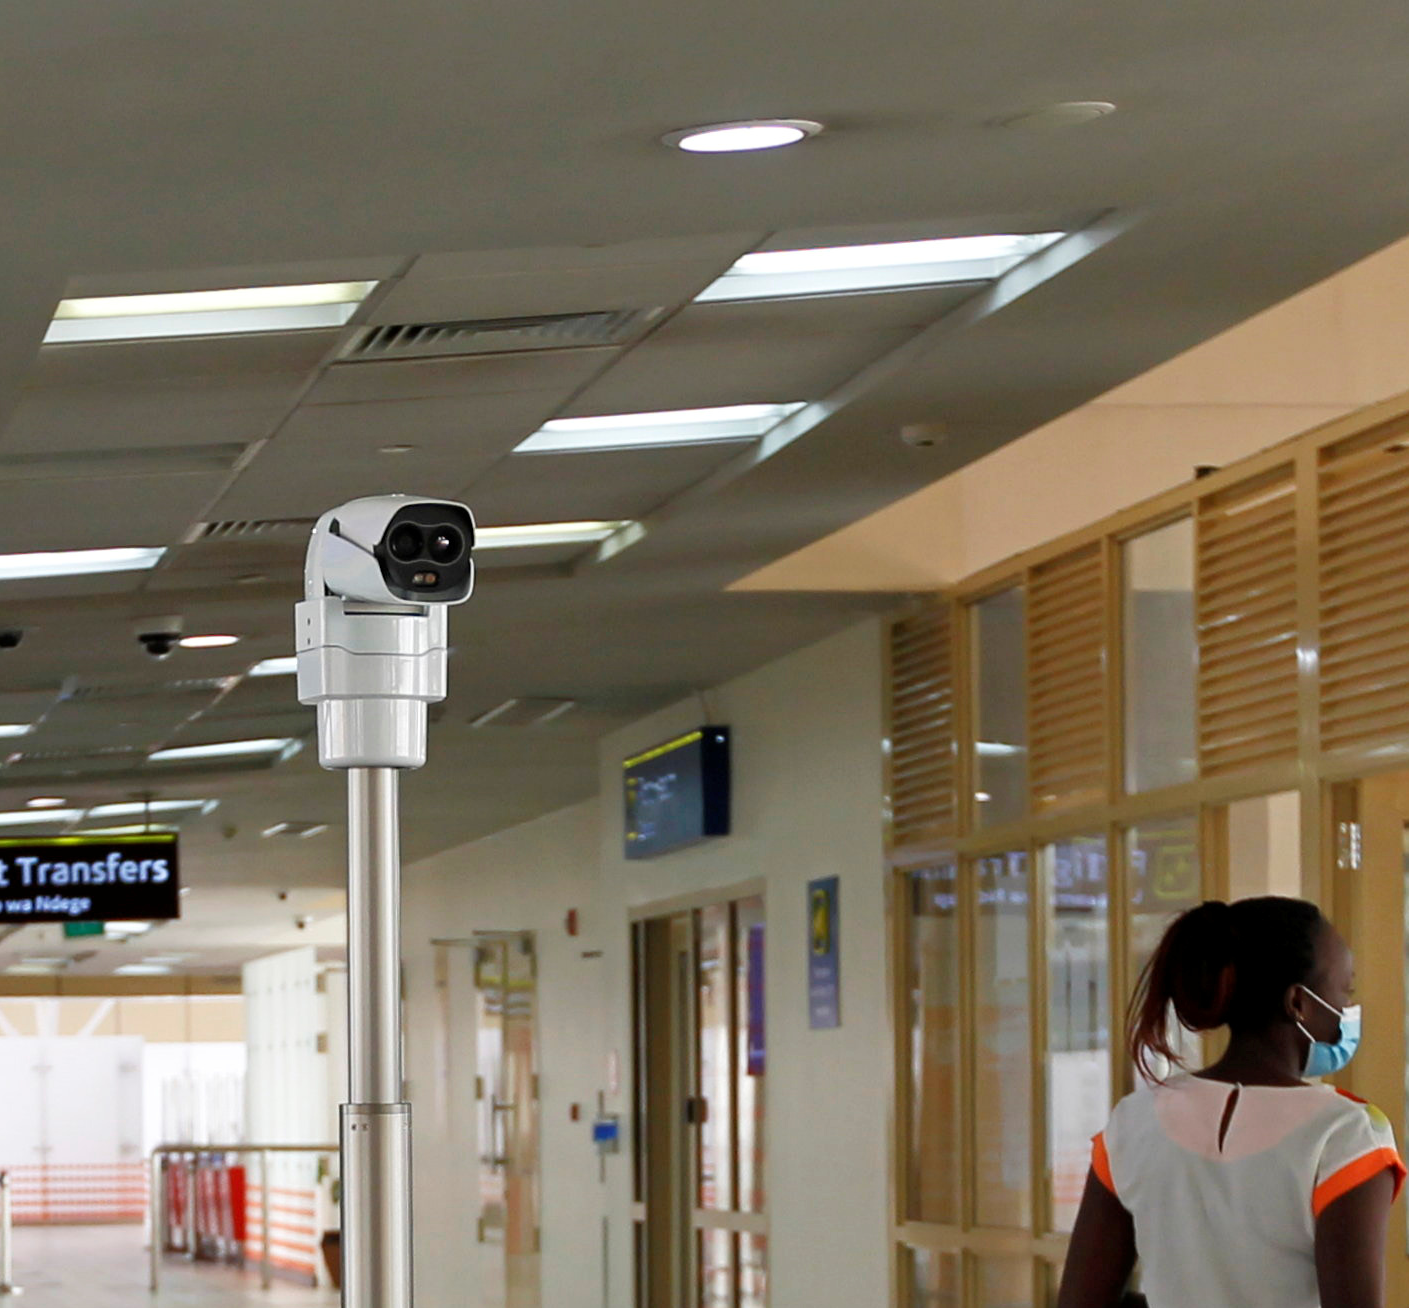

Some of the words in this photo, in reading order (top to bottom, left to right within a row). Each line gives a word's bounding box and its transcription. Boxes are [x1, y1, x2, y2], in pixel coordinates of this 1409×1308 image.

[15, 852, 169, 886] Transfers
[6, 900, 32, 914] wa
[36, 896, 91, 916] Ndege
